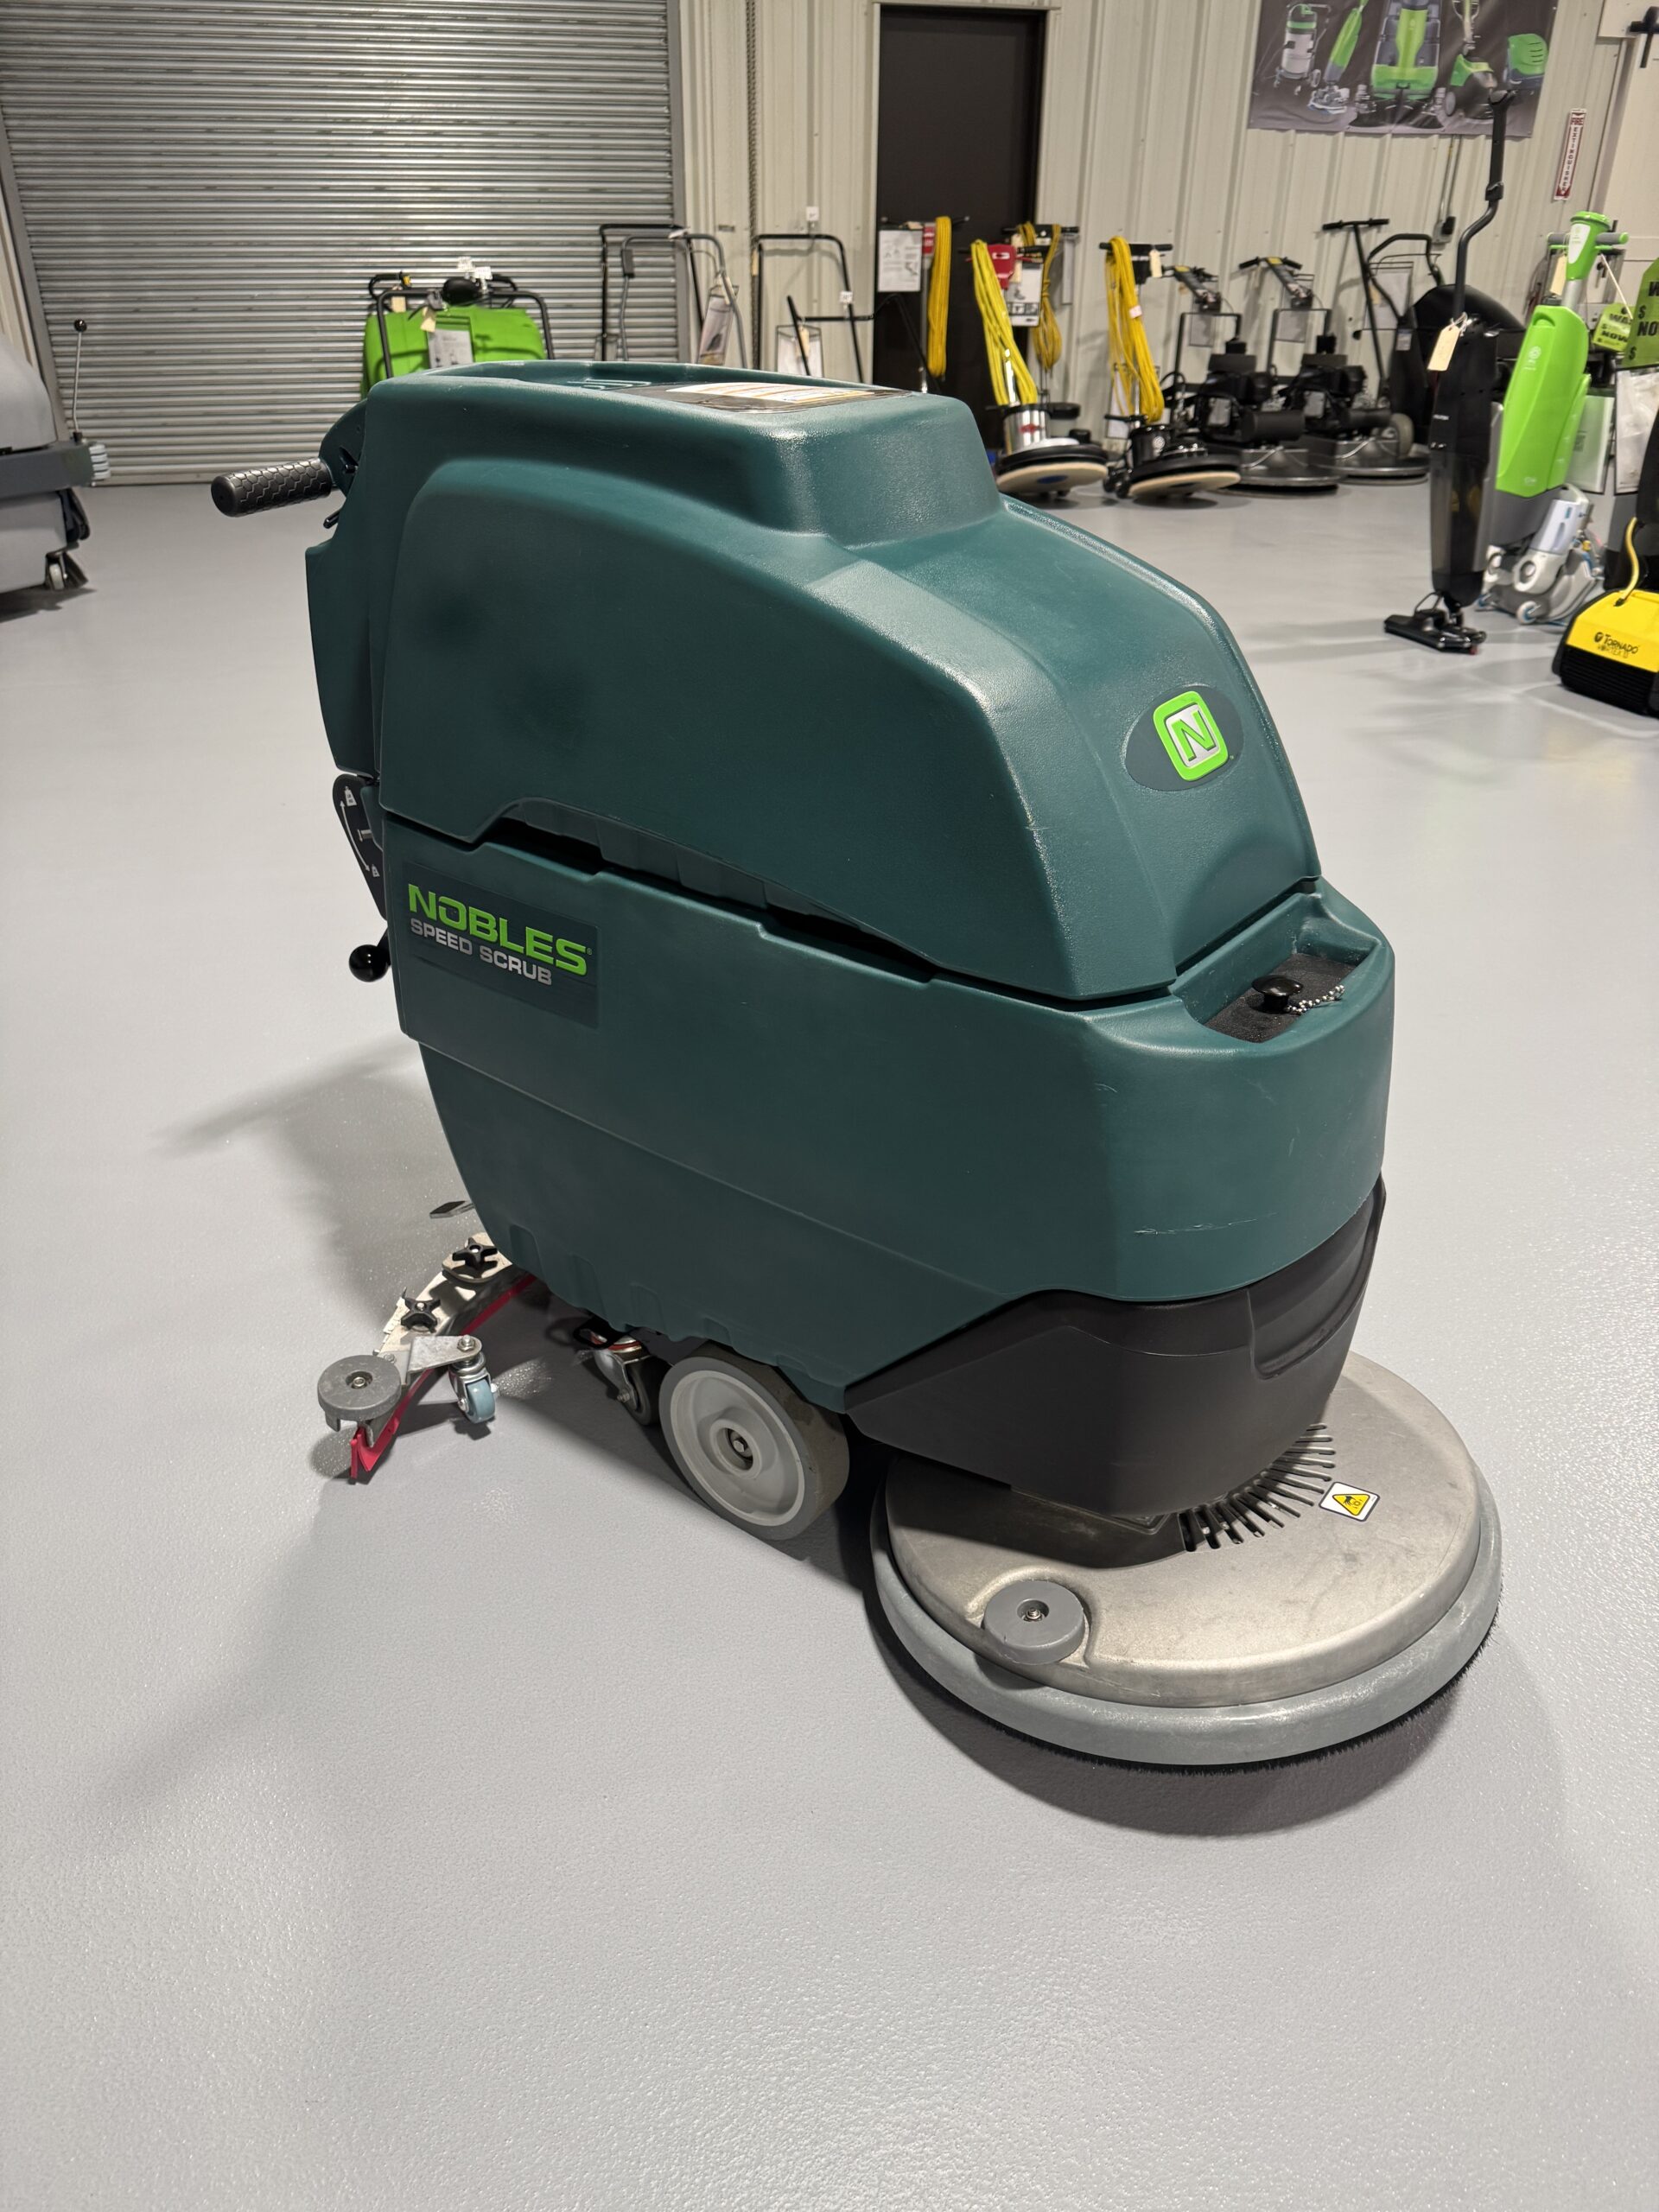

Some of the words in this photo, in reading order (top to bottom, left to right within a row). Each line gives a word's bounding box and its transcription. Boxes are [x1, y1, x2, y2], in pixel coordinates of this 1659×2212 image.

[1637, 321, 1659, 337] NO
[410, 918, 474, 956] SPEED
[479, 944, 552, 986] SCRUB
